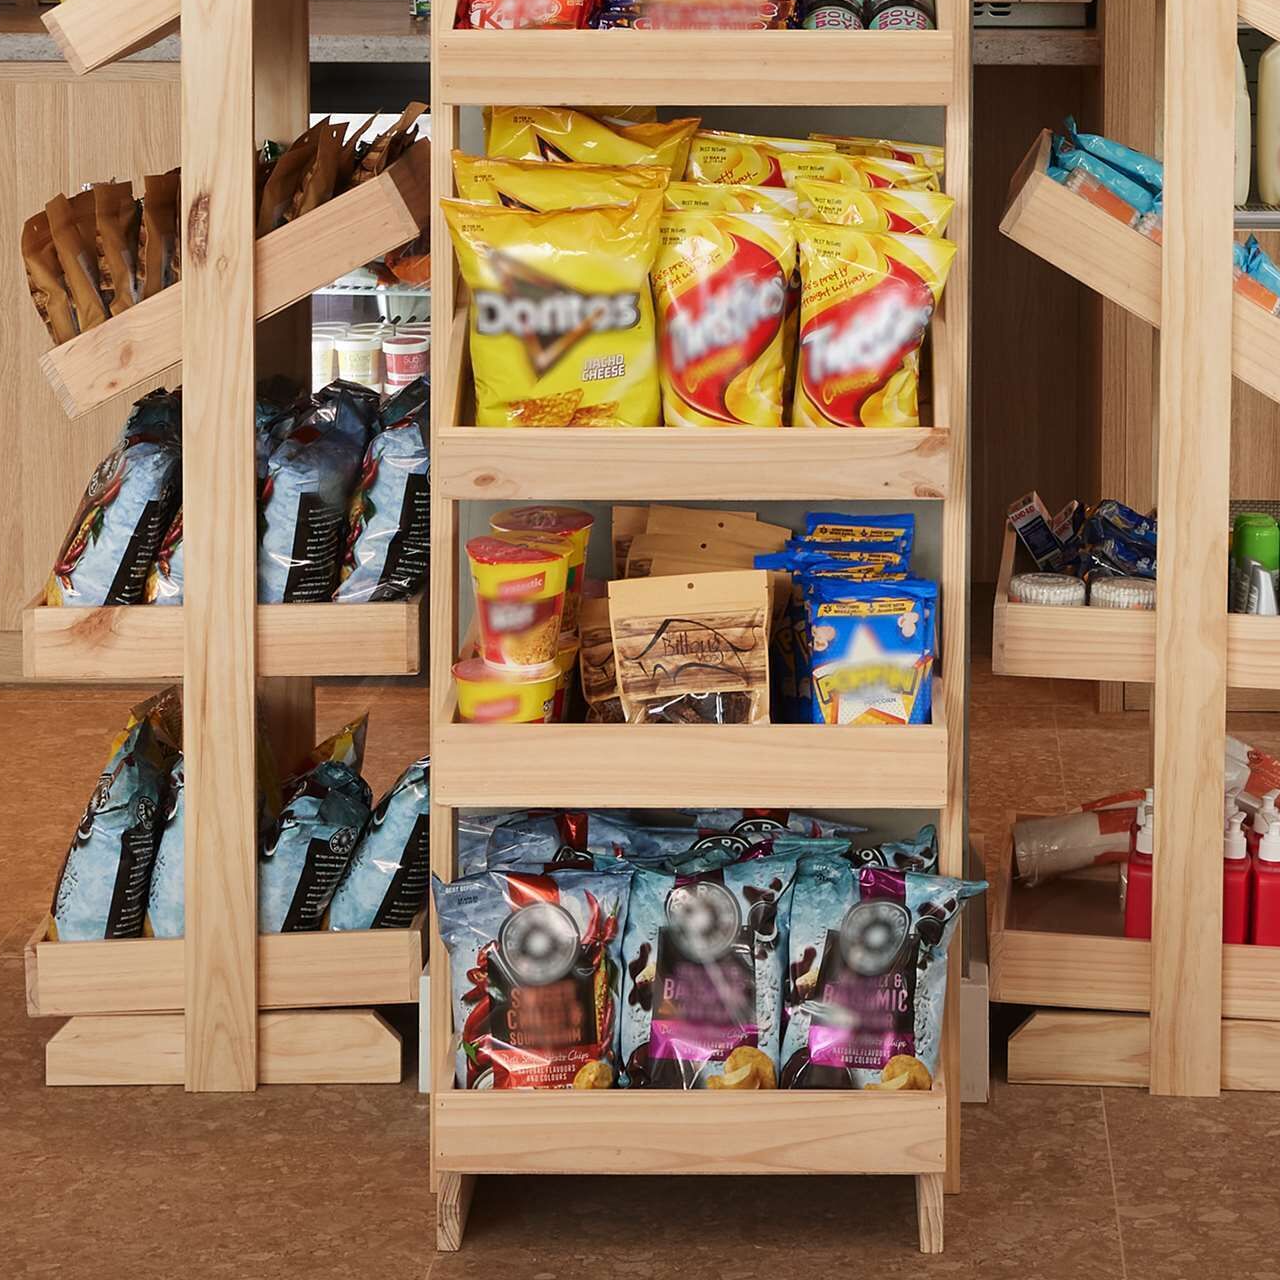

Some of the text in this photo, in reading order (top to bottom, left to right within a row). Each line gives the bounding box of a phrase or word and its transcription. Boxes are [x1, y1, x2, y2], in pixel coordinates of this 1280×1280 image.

[820, 265, 849, 287] pretty
[583, 354, 624, 371] NACHO
[582, 364, 625, 382] CHEESE
[568, 1049, 590, 1064] Chips
[854, 1056, 881, 1065] COLOURS
[546, 1064, 576, 1073] FLAVOURS
[526, 1072, 567, 1083] AND COLOURS
